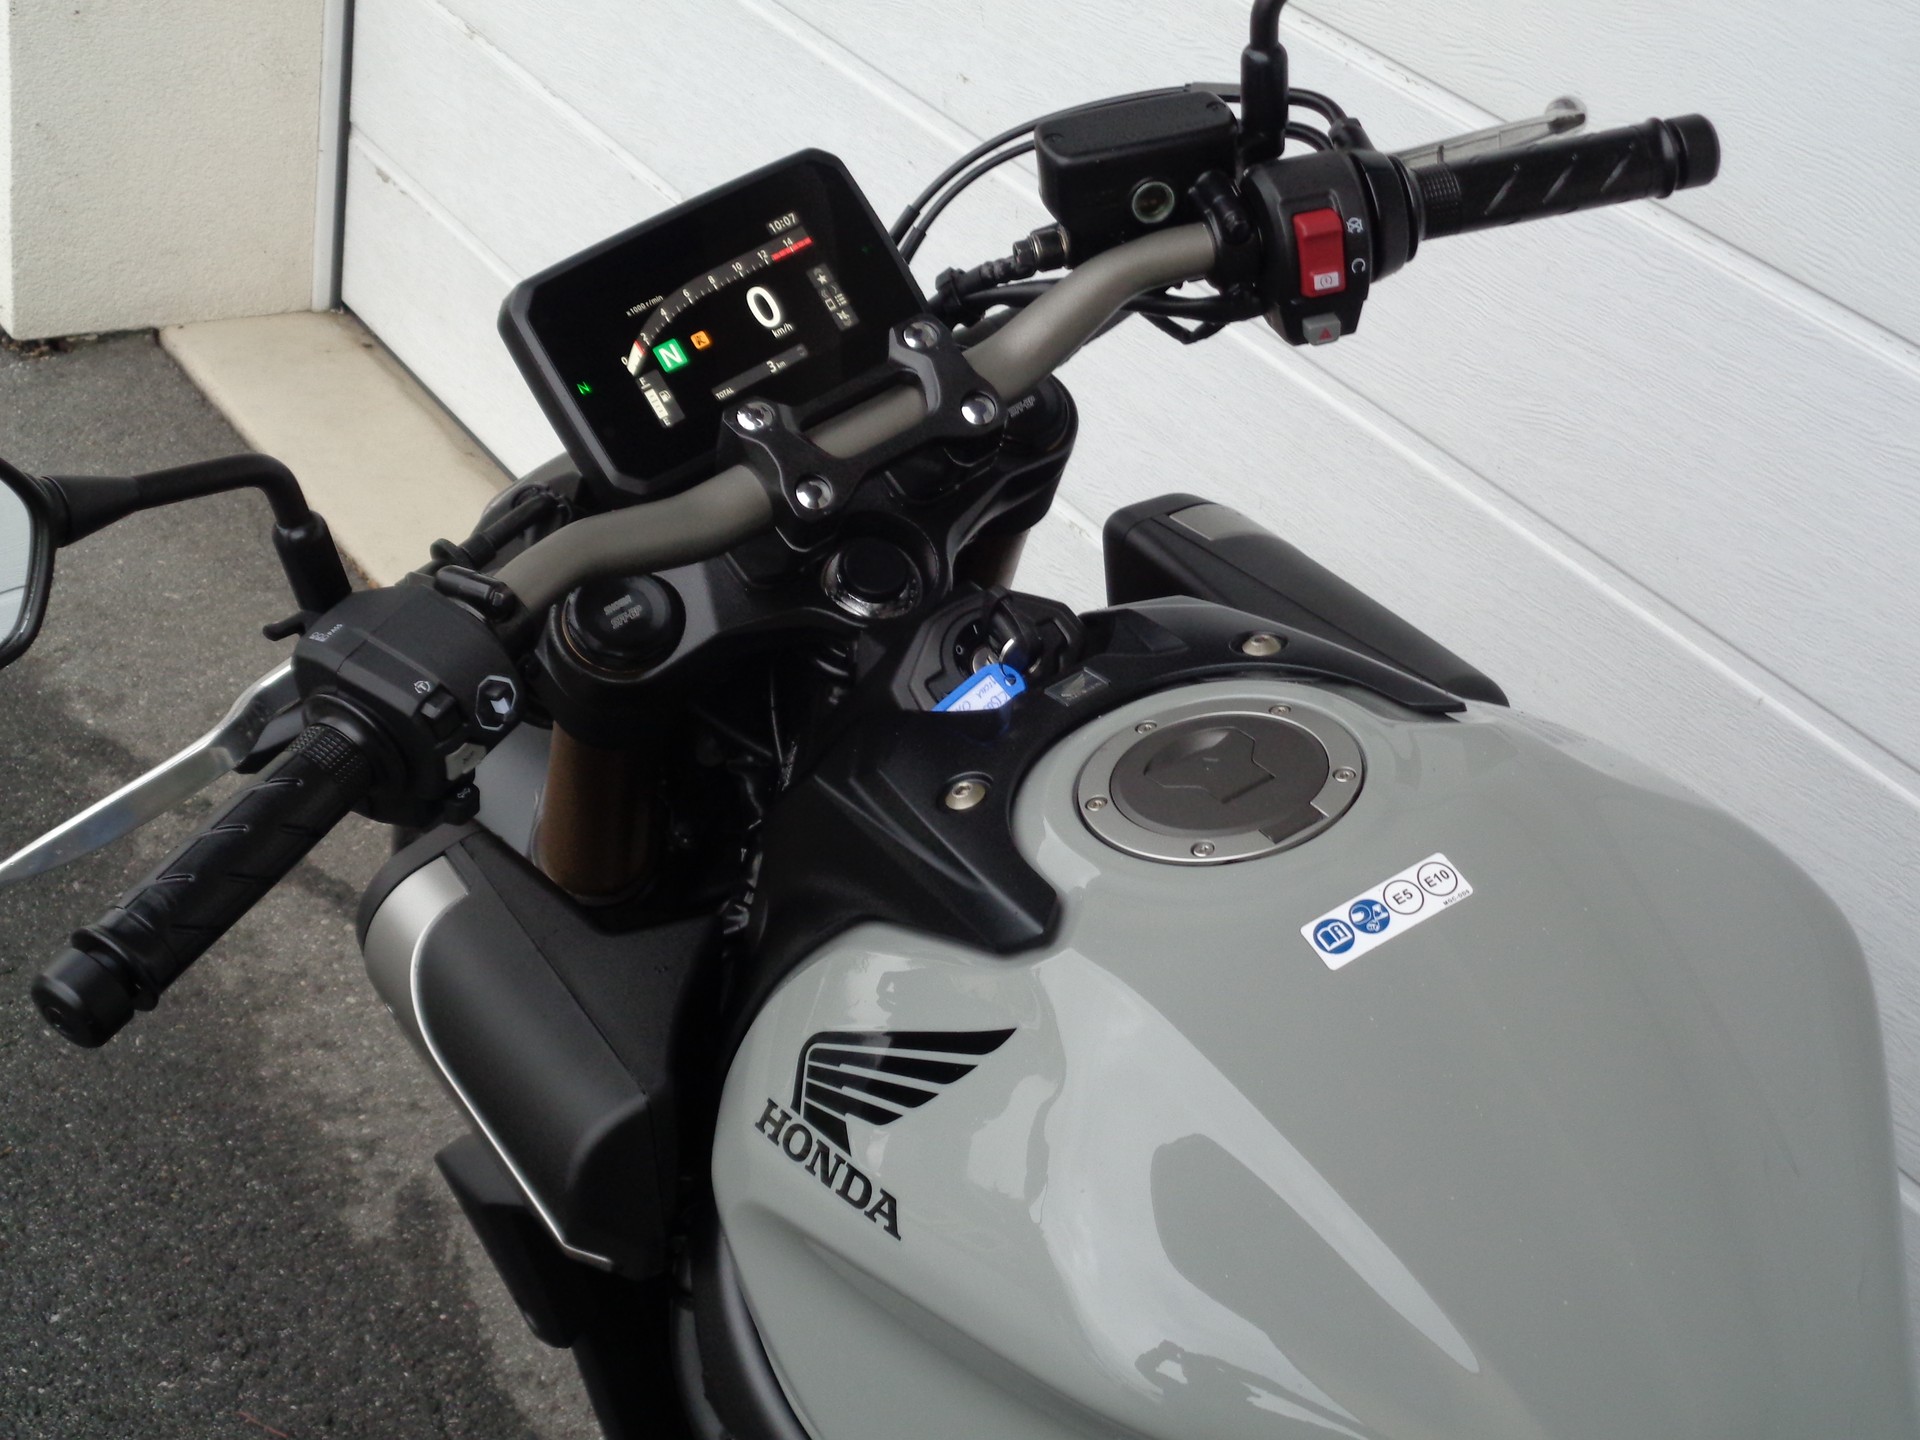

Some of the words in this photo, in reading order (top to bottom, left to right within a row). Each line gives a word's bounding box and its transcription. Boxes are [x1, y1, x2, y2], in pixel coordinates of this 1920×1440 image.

[768, 212, 797, 234] 10:07
[782, 237, 793, 248] 14
[756, 249, 769, 261] 12
[731, 261, 743, 273] 10
[707, 275, 716, 285] 8
[682, 288, 690, 298] 6
[746, 286, 781, 328] 0
[771, 322, 794, 339] km/h
[620, 356, 628, 366] 0
[658, 343, 683, 369] N
[766, 360, 777, 373] 3
[776, 361, 787, 370] km
[576, 381, 591, 395] N
[715, 387, 735, 401] TOTAL
[1424, 869, 1450, 889] E10
[1392, 888, 1414, 906] E5
[755, 1098, 901, 1241] HONDA
